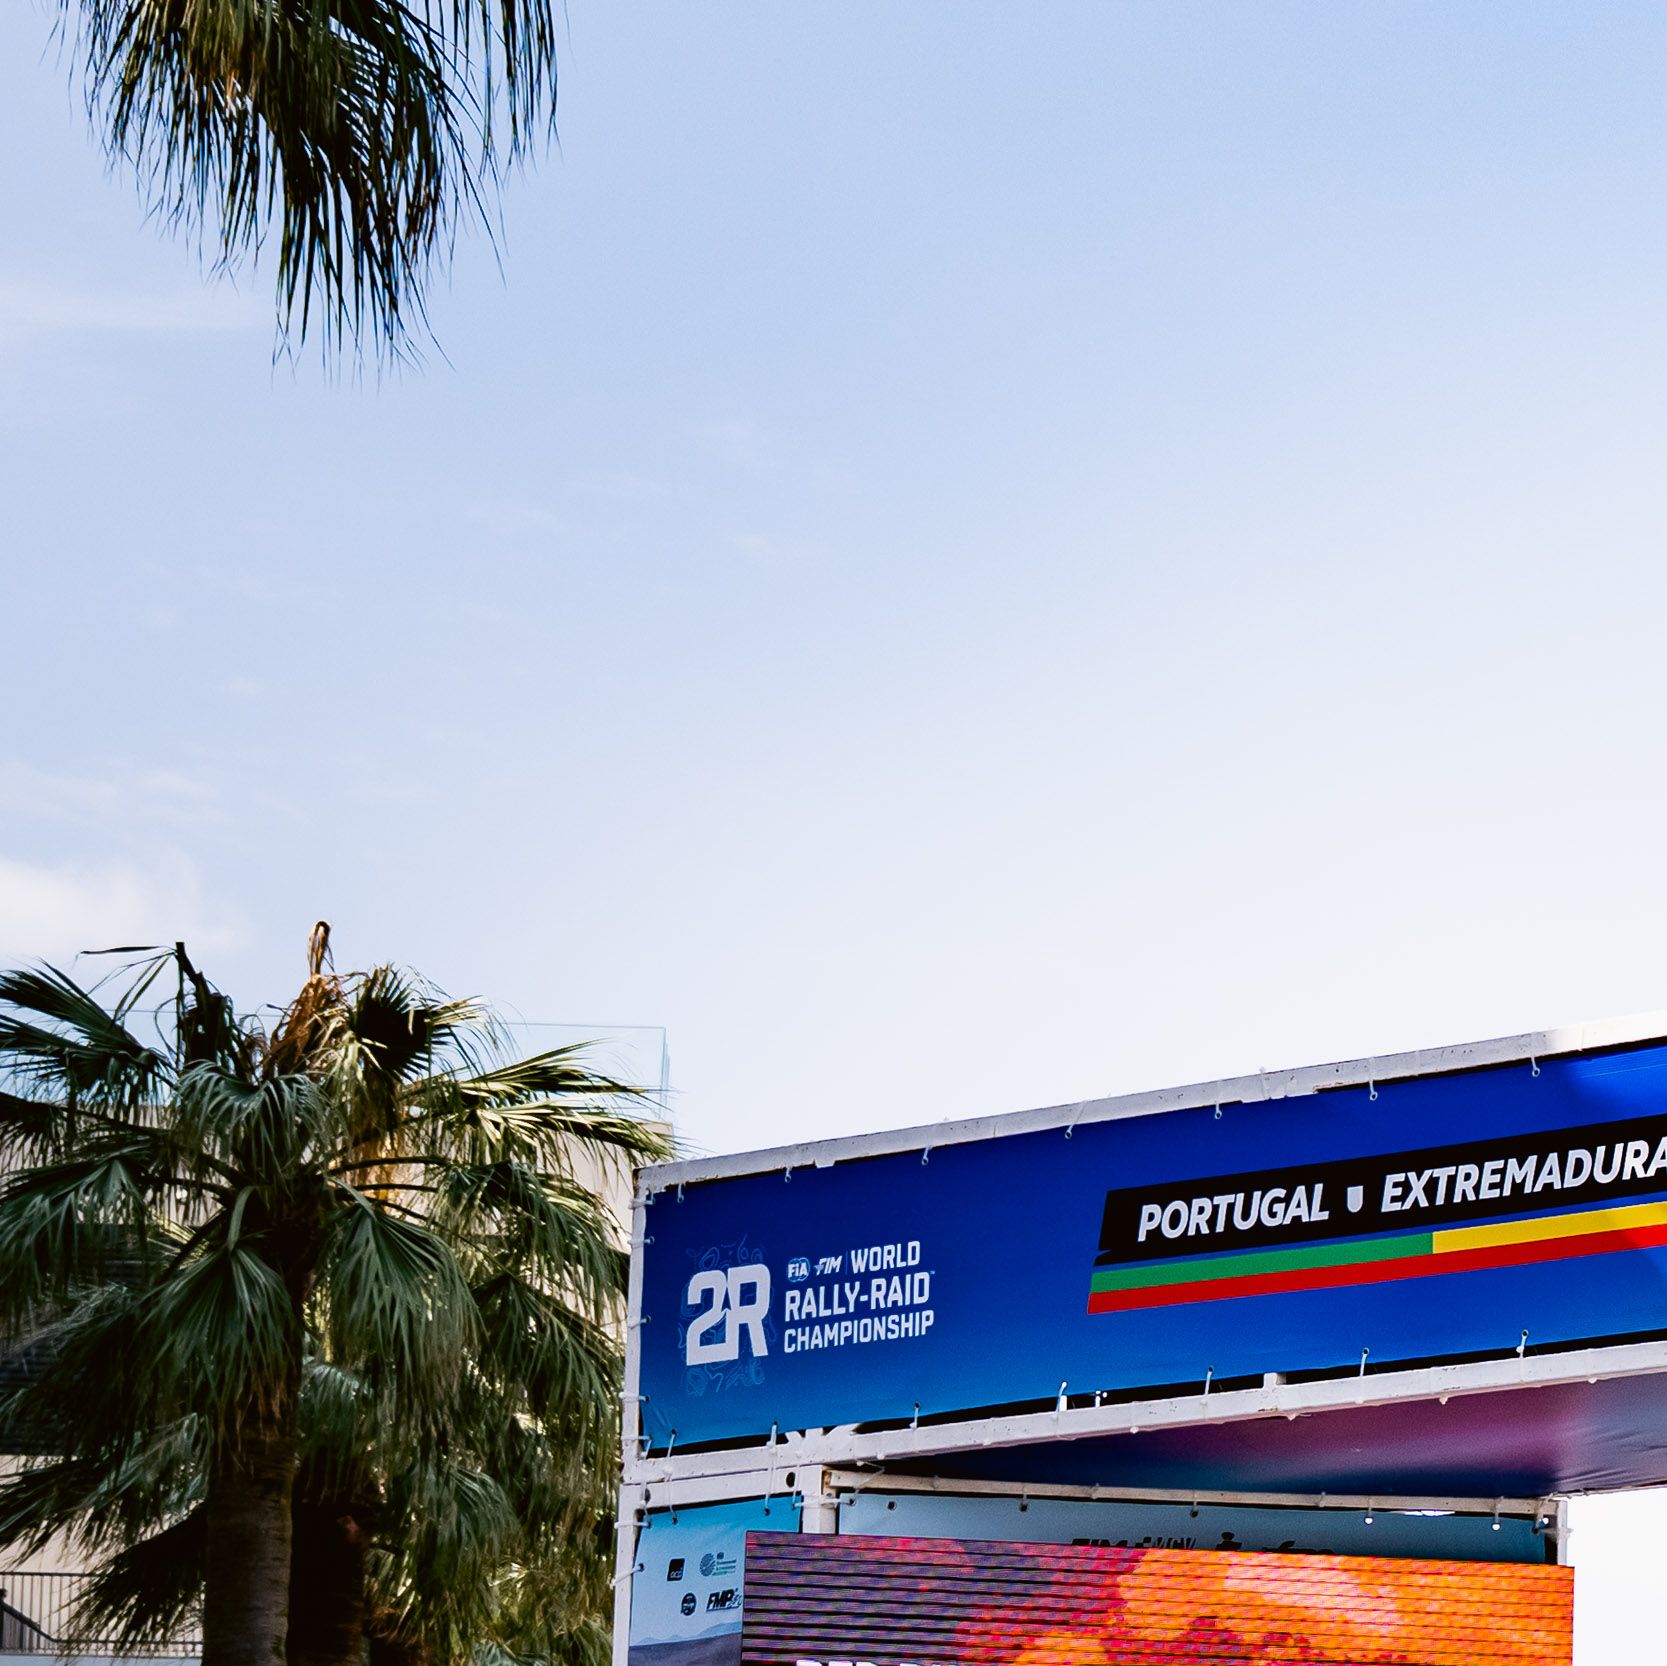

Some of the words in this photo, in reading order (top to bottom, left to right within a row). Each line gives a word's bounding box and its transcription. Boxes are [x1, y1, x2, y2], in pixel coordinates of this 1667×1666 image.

[1137, 1183, 1330, 1244] PORTUGAL
[850, 1240, 921, 1274] WORLD
[686, 1263, 770, 1366] 2R
[784, 1271, 931, 1322] RALLY-RAID
[783, 1309, 935, 1353] CHAMPIONSHIP
